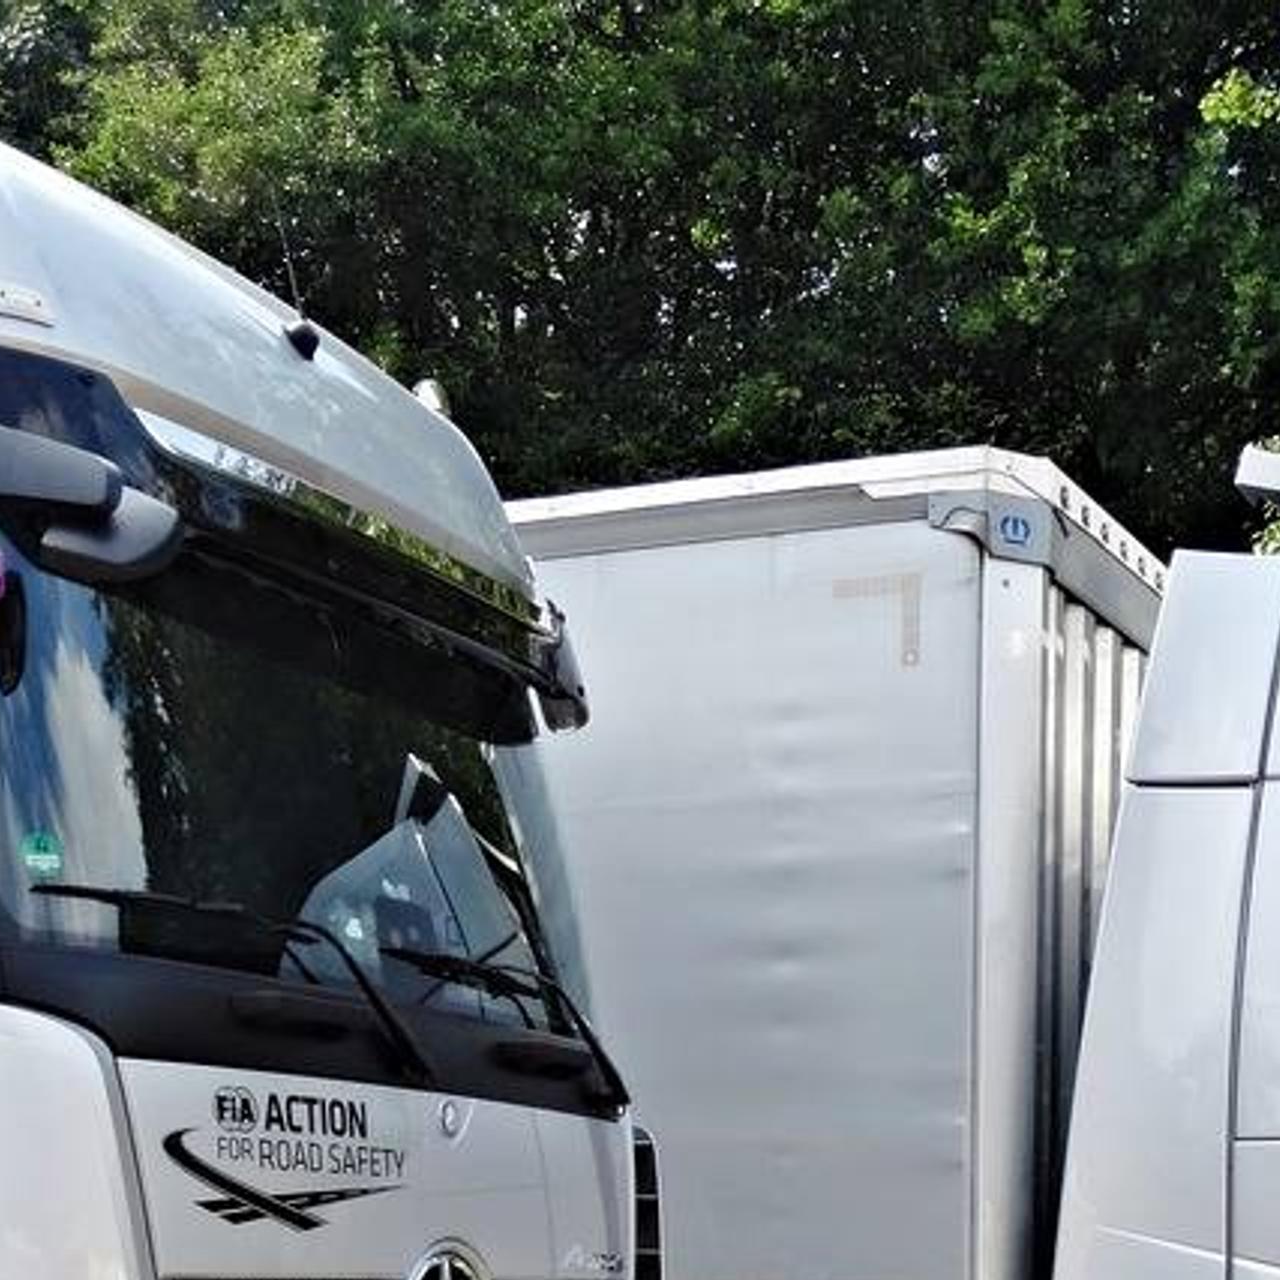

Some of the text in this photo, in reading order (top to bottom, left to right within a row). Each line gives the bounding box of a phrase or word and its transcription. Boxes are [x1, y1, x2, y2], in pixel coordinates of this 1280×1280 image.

[264, 1094, 369, 1138] ACTION
[216, 1136, 405, 1178] FOR ROAD SAFETY
